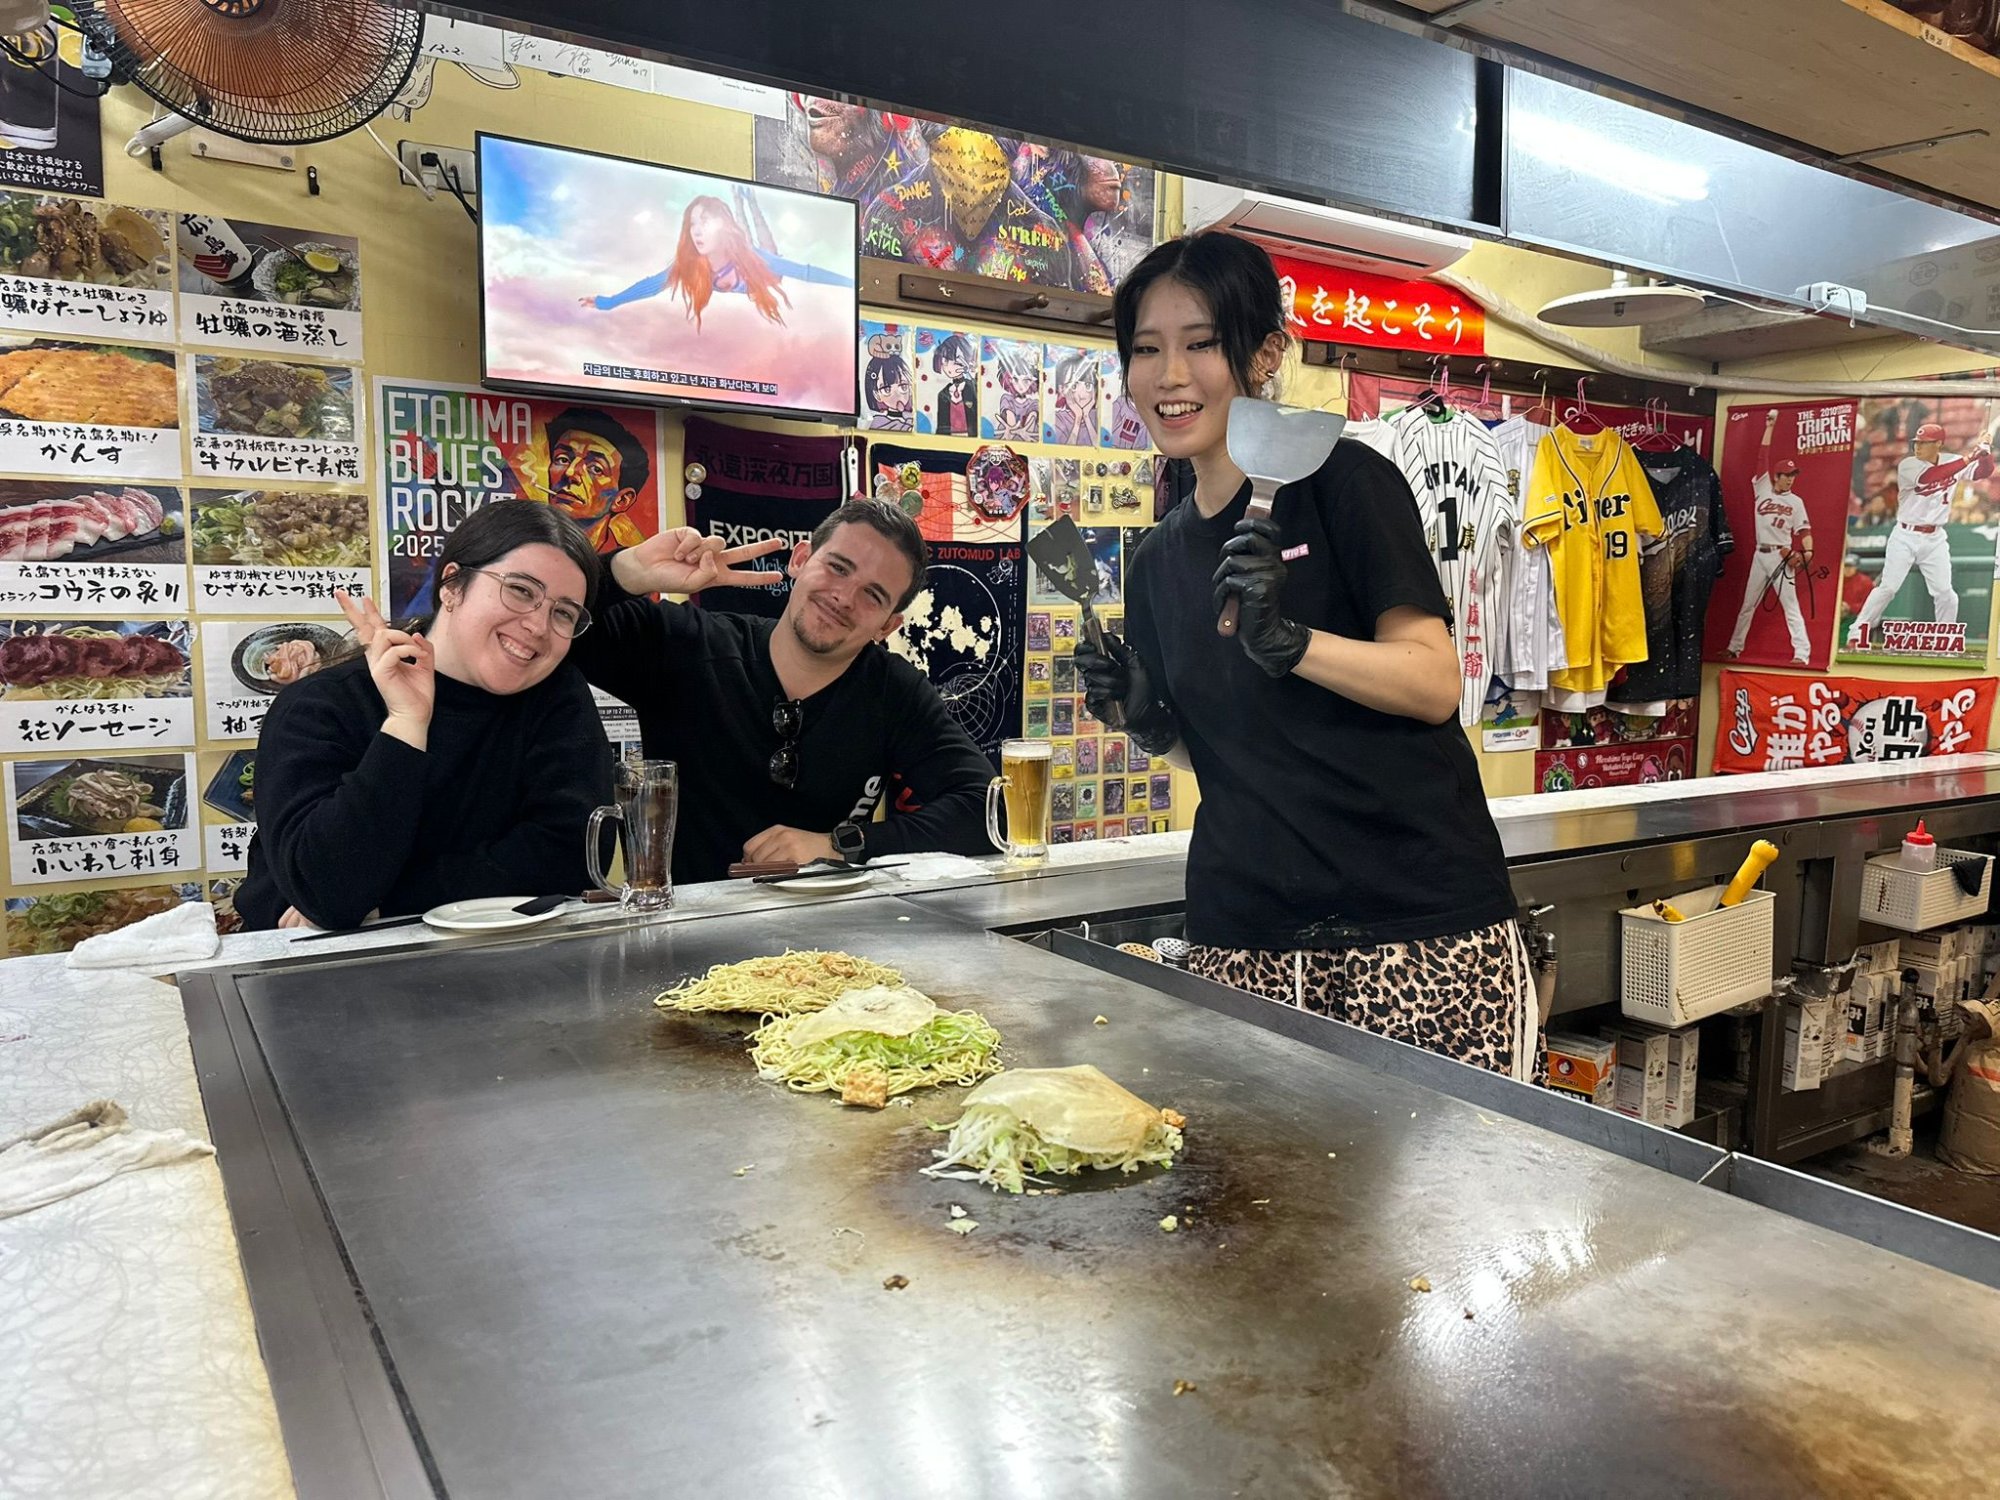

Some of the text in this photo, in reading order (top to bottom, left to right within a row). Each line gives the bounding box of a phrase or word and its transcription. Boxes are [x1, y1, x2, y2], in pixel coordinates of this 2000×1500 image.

[0, 172, 99, 191] いな黒いレモンサワー
[894, 180, 932, 201] DANCE
[866, 228, 903, 257] KING
[0, 293, 168, 326] 蠣ばたーしょうゆ
[1278, 275, 1463, 346] 風を起こそう
[196, 313, 348, 347] 牡蠣の酒蒸し
[584, 364, 611, 376] 지금의
[613, 367, 631, 379] 너는
[700, 377, 717, 388] 지금
[388, 391, 532, 445] ETAJIMA
[1797, 410, 1815, 421] THE
[1797, 414, 1847, 435] TRIPLE
[1797, 429, 1851, 451] CROWN
[40, 443, 122, 465] がんす
[199, 451, 359, 478] 牛カルビたれ焼
[389, 440, 503, 489] BLUES
[695, 444, 842, 489] 永遠深夜万国
[391, 487, 517, 533] ROCK
[1438, 496, 1458, 562] 1
[393, 534, 445, 557] 2025
[1604, 530, 1628, 560] 19
[18, 565, 157, 580] 広島でしか味わえない
[1857, 623, 1870, 649] 1
[1884, 622, 1965, 635] TOMONORI
[1884, 635, 1965, 652] MAEDA
[56, 702, 135, 714] がんばる子に
[1938, 687, 1977, 753] やる
[18, 718, 172, 741] 花ソーセージ
[1728, 687, 1760, 757] Carp
[1808, 682, 1842, 763] やる?
[1855, 717, 1877, 757] You
[32, 846, 180, 874] 小いわし刺身
